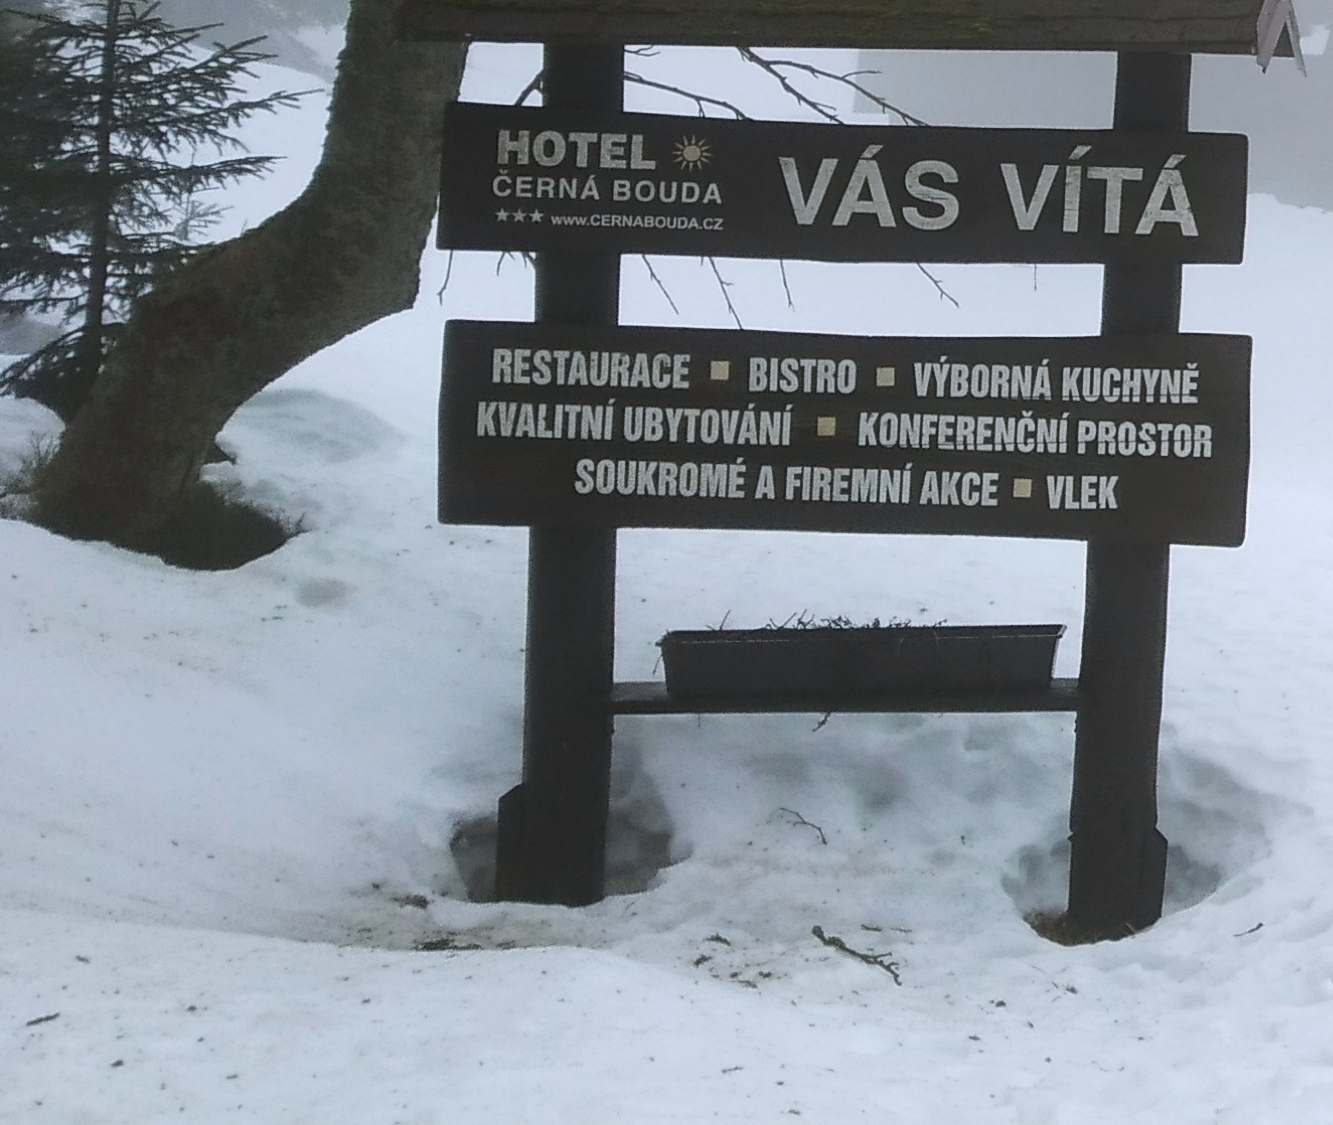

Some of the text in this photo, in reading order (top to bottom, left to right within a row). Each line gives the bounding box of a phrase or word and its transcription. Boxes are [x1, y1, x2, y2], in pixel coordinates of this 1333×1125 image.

[497, 130, 656, 170] HOTEL
[492, 169, 722, 205] ČERNÁ BOUDA
[778, 144, 1199, 236] VÁS VÍTÁ
[551, 214, 724, 231] www.CERNABOUDA.CZ
[492, 348, 1200, 404] RESTAURACE BISTRO VÝBORNÁ KUCHYNĚ
[476, 398, 1212, 458] KVALITNÍ UBYTOVÁNÍ KONFERENČNÍ PROSTOR
[574, 457, 1119, 510] SOUKROMÉ A FIREMNÍ AKCE VLEK
